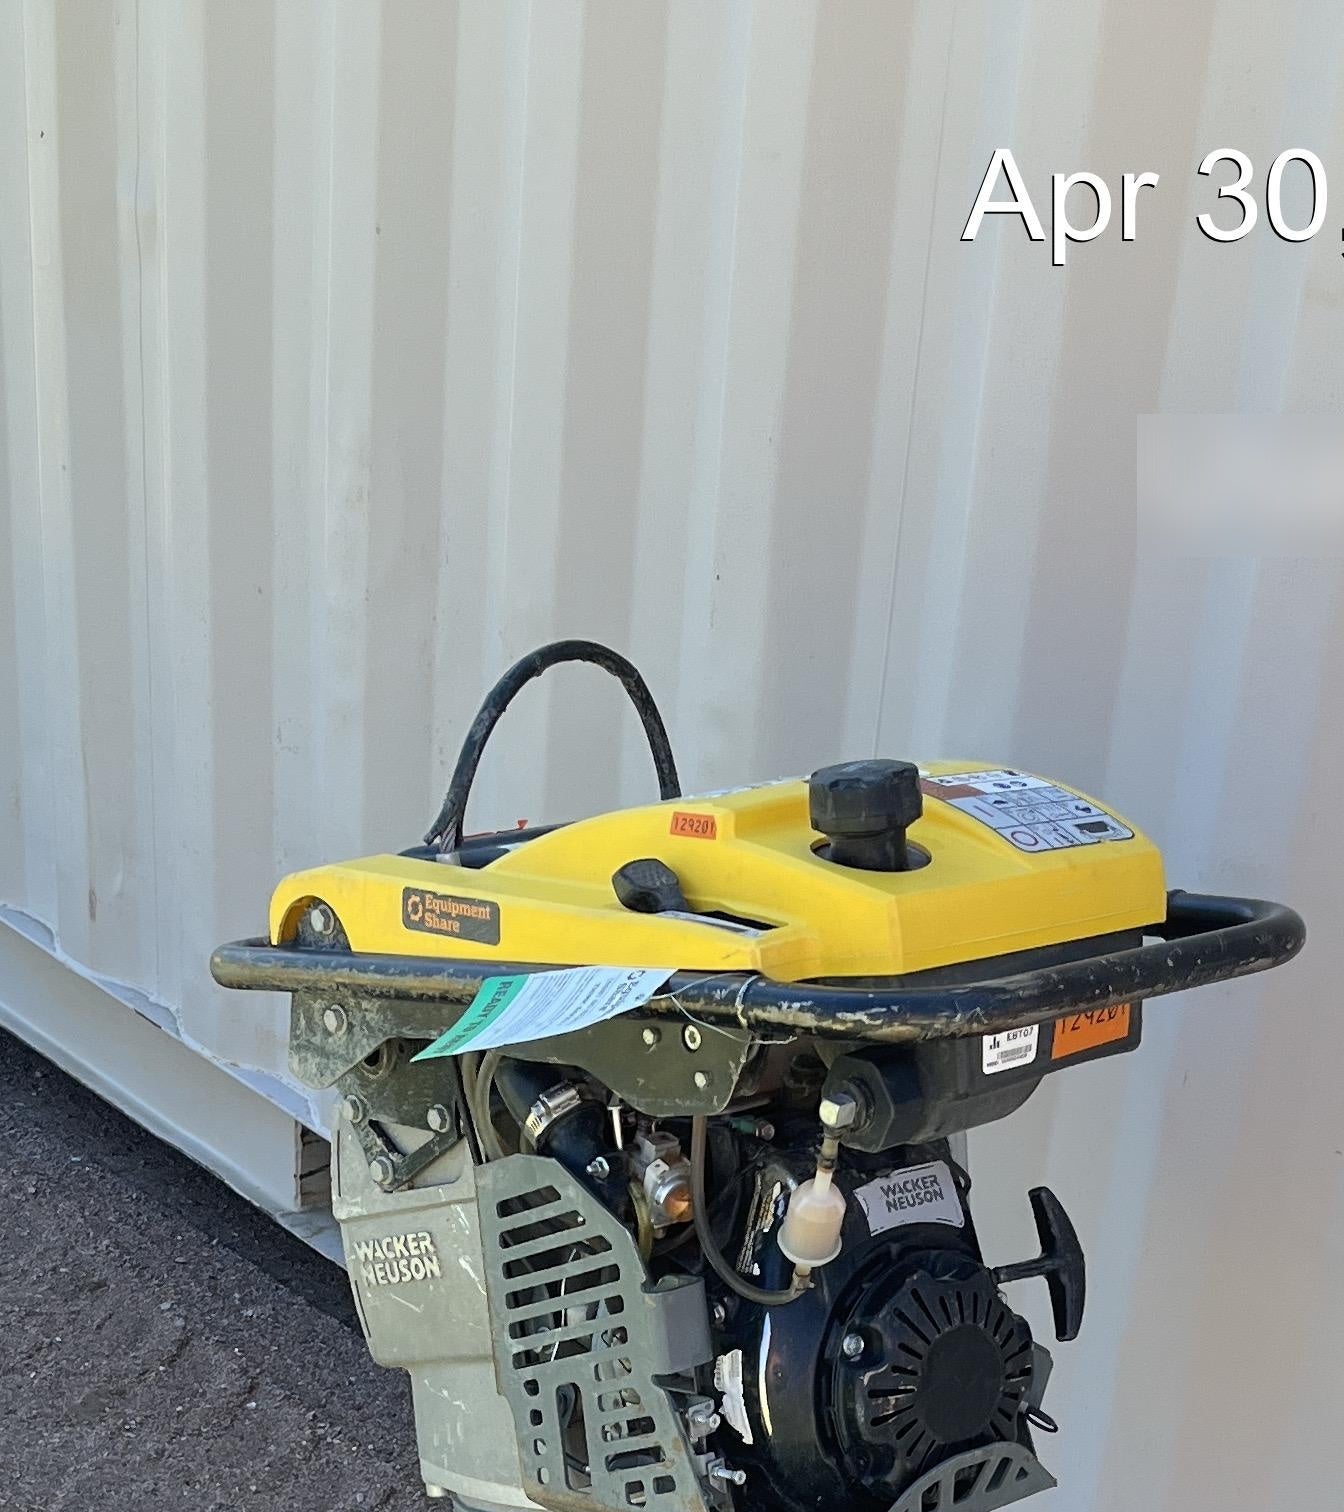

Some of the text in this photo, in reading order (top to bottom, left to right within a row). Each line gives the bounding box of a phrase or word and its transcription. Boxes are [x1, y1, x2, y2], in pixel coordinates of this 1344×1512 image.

[425, 894, 490, 920] Equipment
[424, 912, 460, 933] Share
[880, 1175, 940, 1199] WACKER
[886, 1187, 944, 1213] NEUSON
[354, 1231, 435, 1261] WACKER
[360, 1255, 441, 1287] NEUSON
